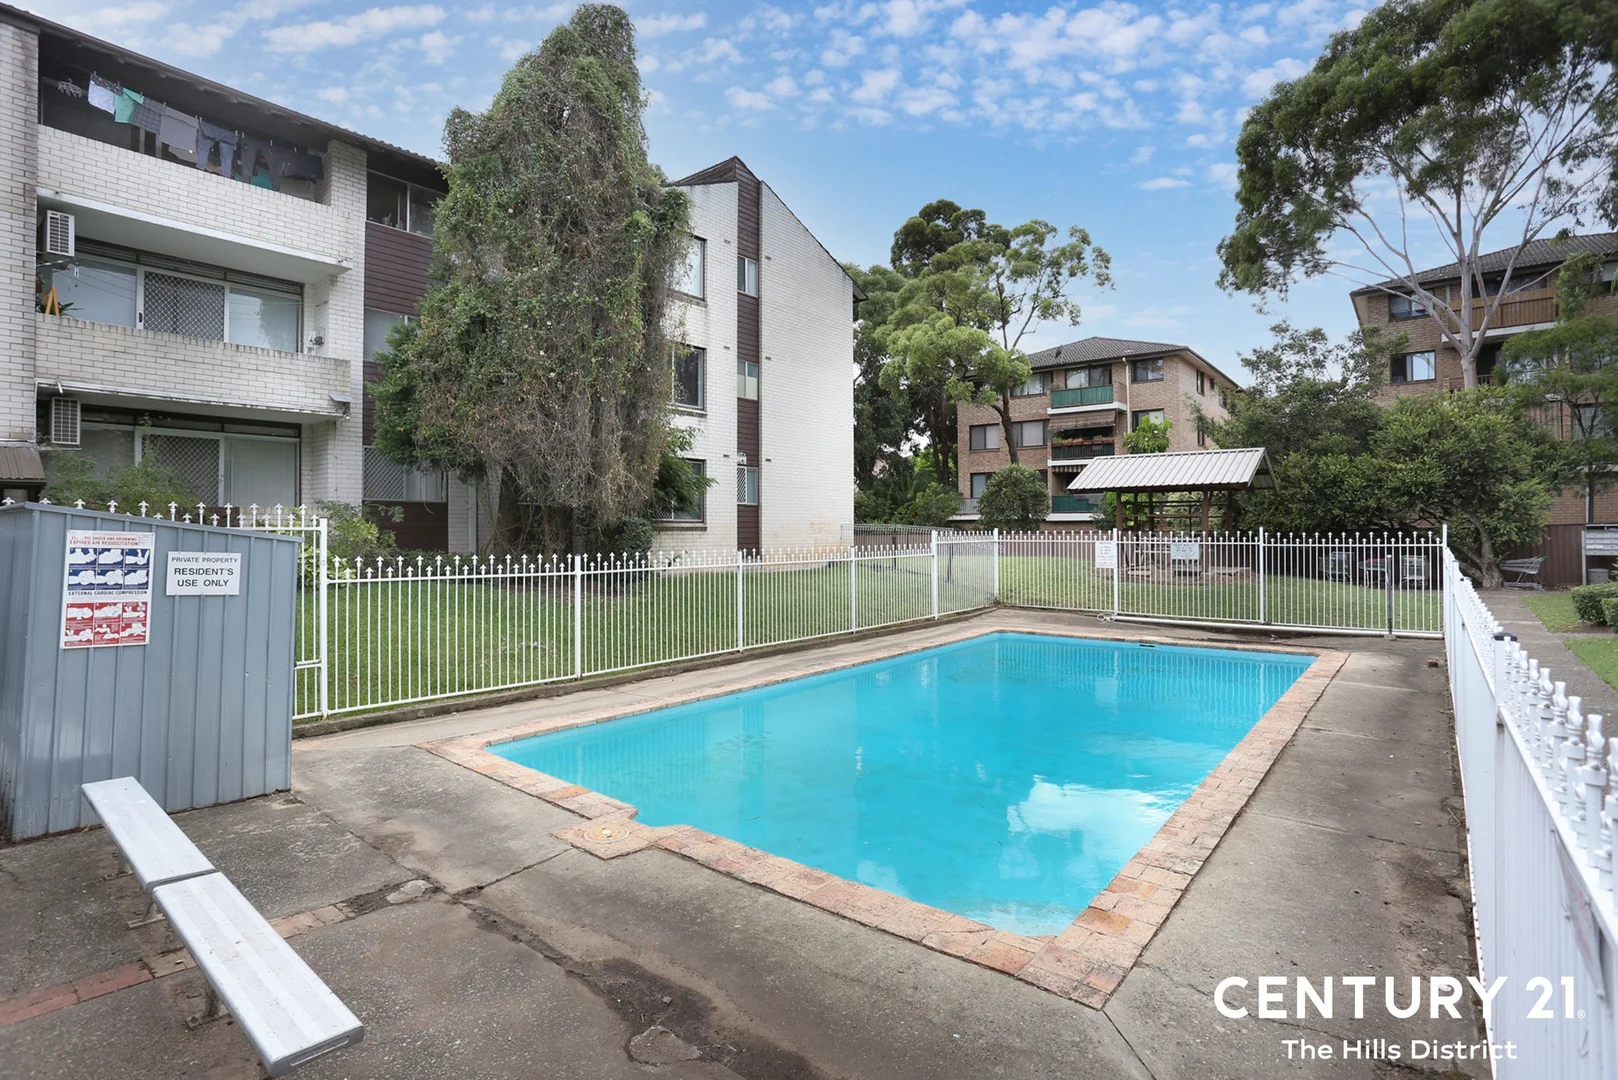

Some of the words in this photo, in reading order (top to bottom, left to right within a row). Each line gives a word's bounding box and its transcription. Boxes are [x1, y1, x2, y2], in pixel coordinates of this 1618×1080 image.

[174, 567, 234, 576] RESIDENT'S
[177, 579, 198, 587] USE
[203, 579, 230, 587] ONLY
